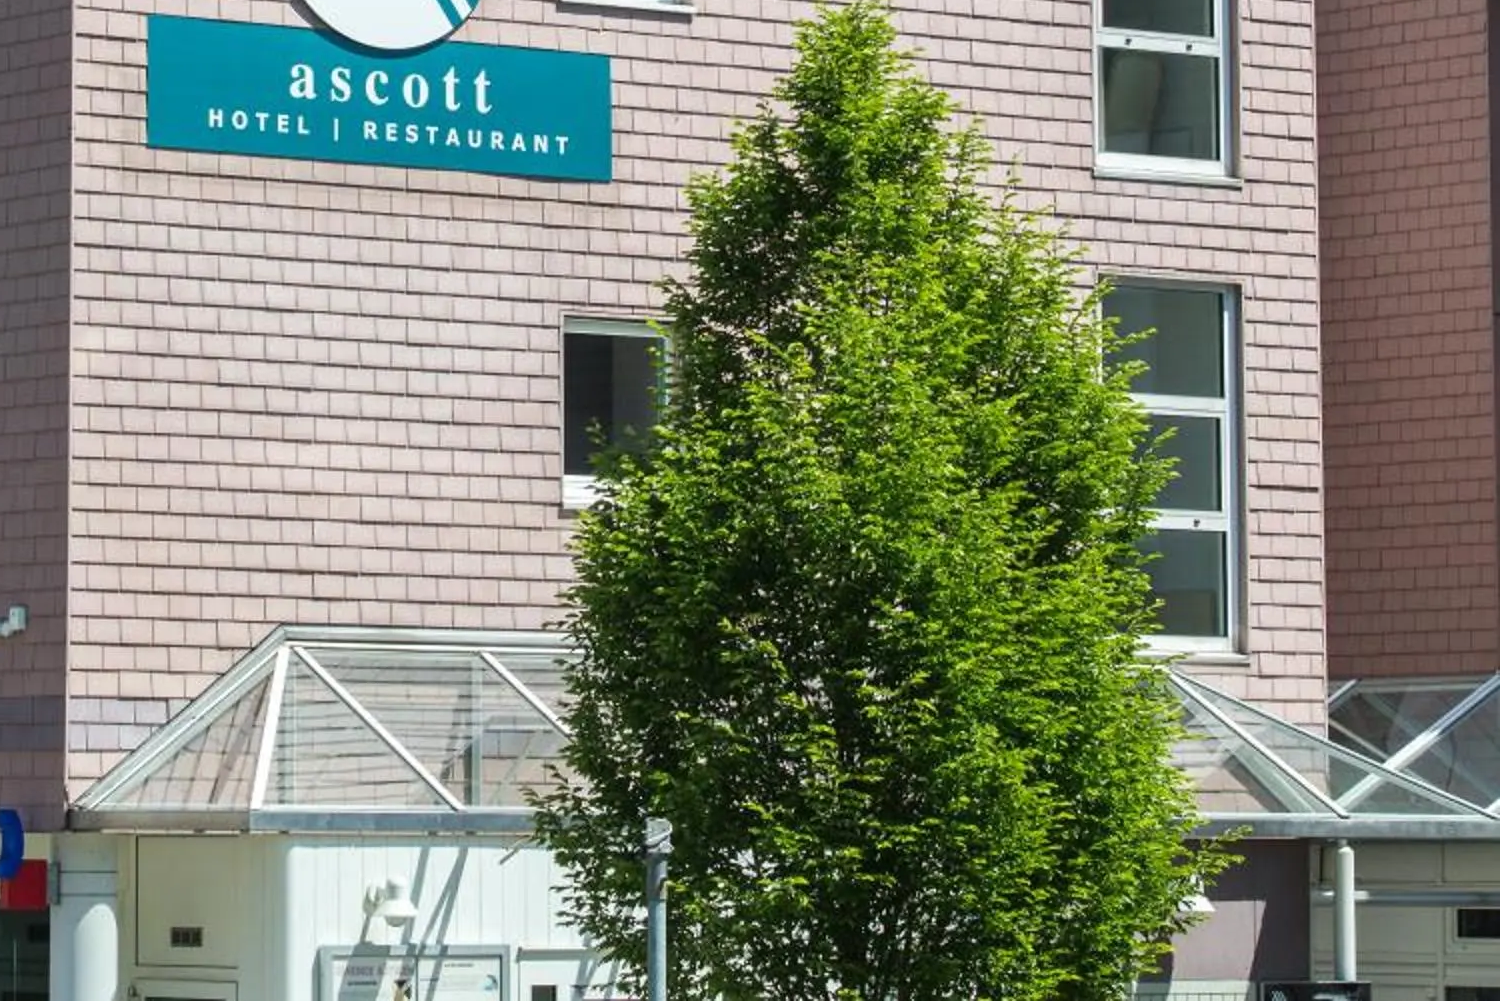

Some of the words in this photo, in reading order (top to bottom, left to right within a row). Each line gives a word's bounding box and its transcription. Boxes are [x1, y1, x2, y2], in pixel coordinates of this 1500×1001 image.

[289, 63, 492, 113] ascott
[208, 109, 311, 135] HOTEL
[363, 122, 570, 155] RESTAURANT
